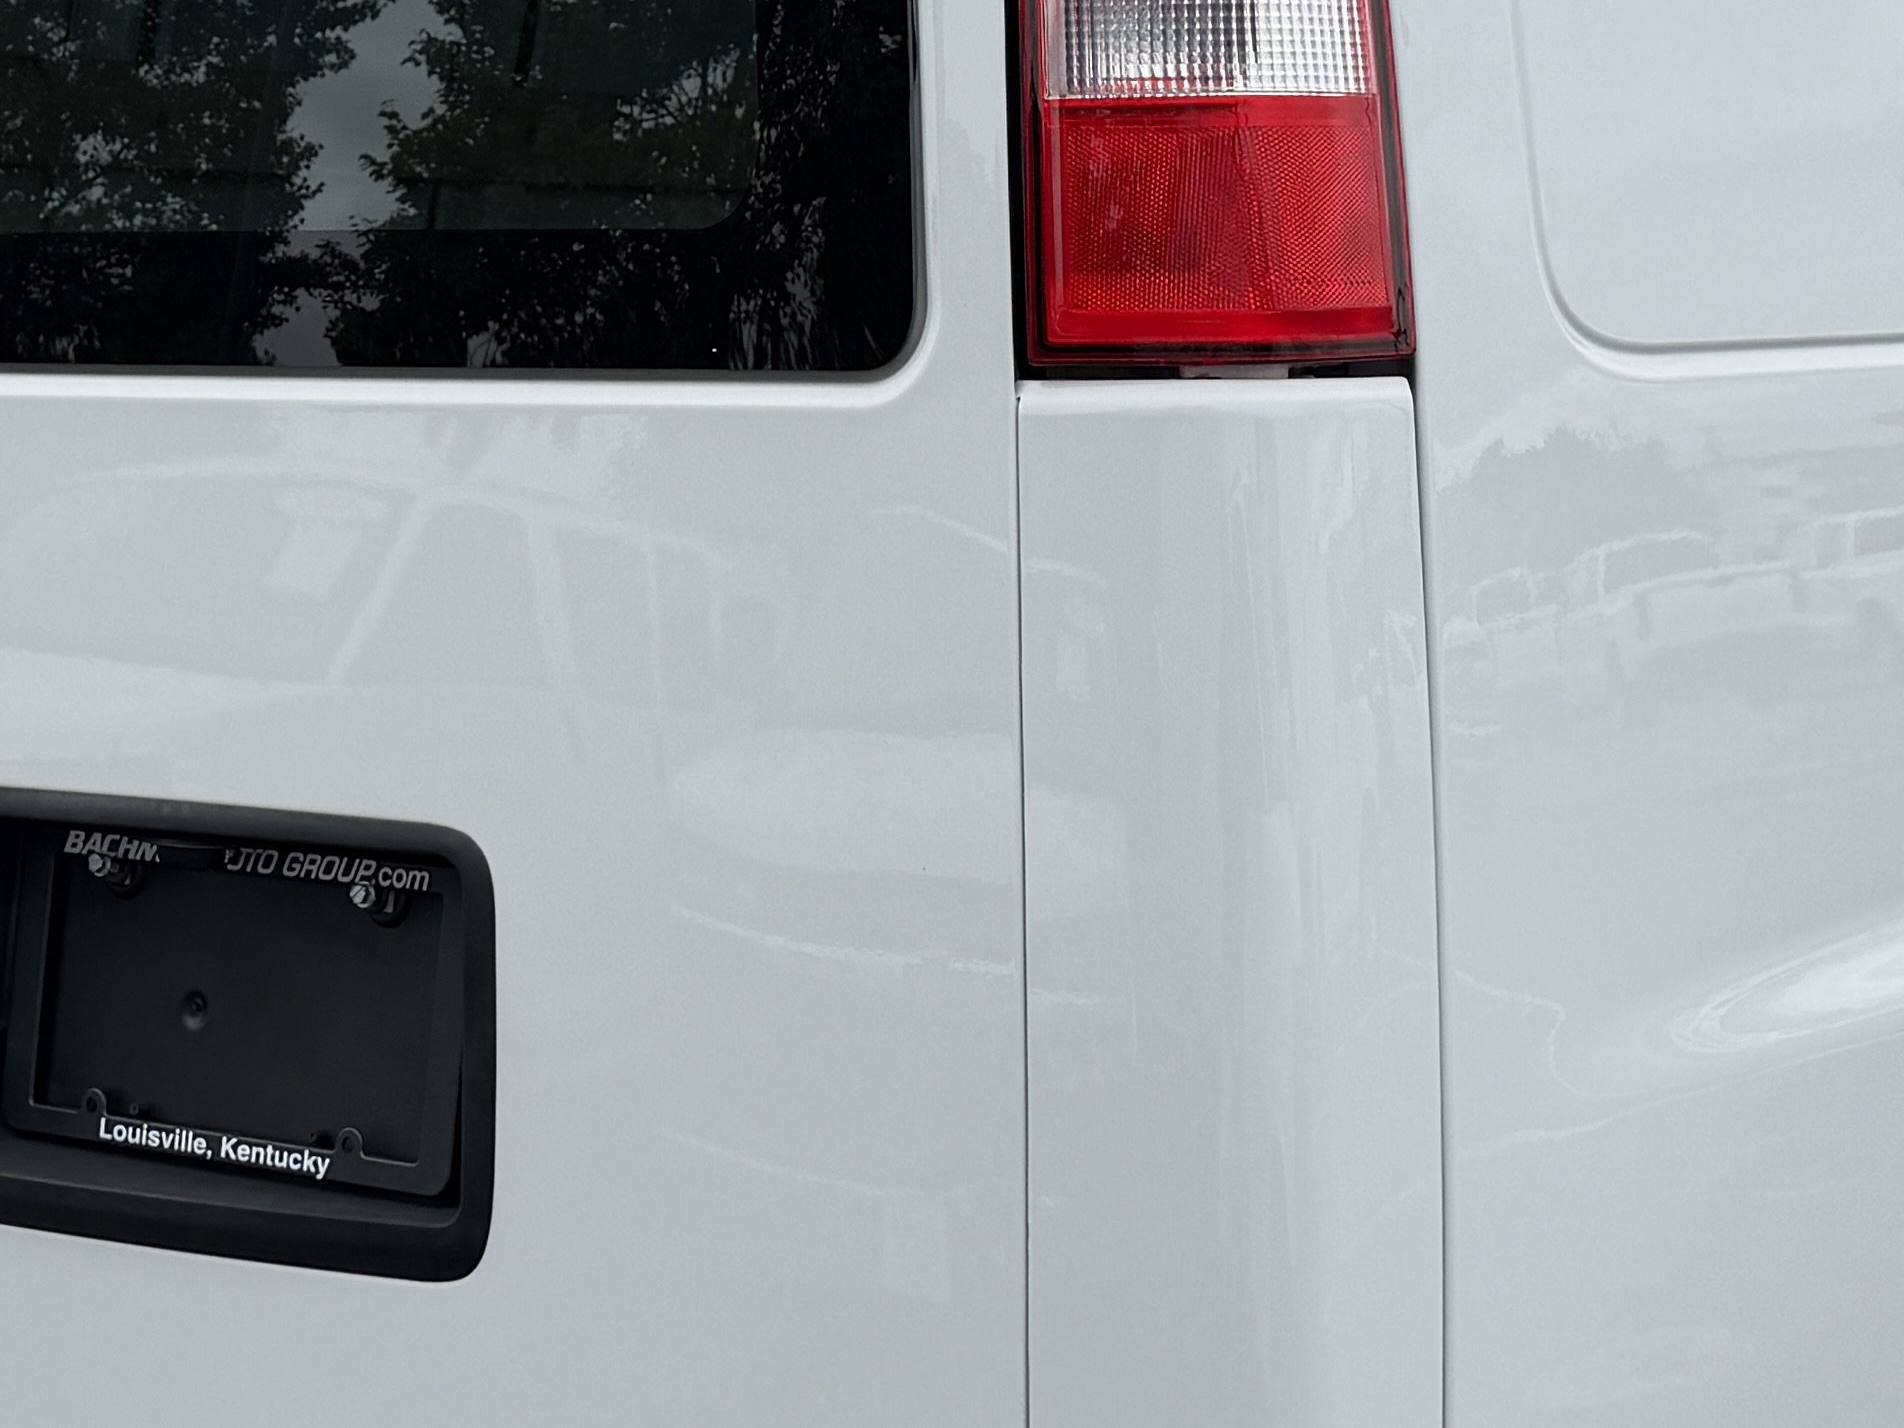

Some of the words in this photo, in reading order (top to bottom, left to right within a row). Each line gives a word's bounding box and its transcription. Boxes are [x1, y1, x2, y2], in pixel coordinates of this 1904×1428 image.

[282, 851, 431, 892] GROUP.com
[97, 1115, 214, 1160] Louisville,
[219, 1134, 332, 1181] Kentucky
